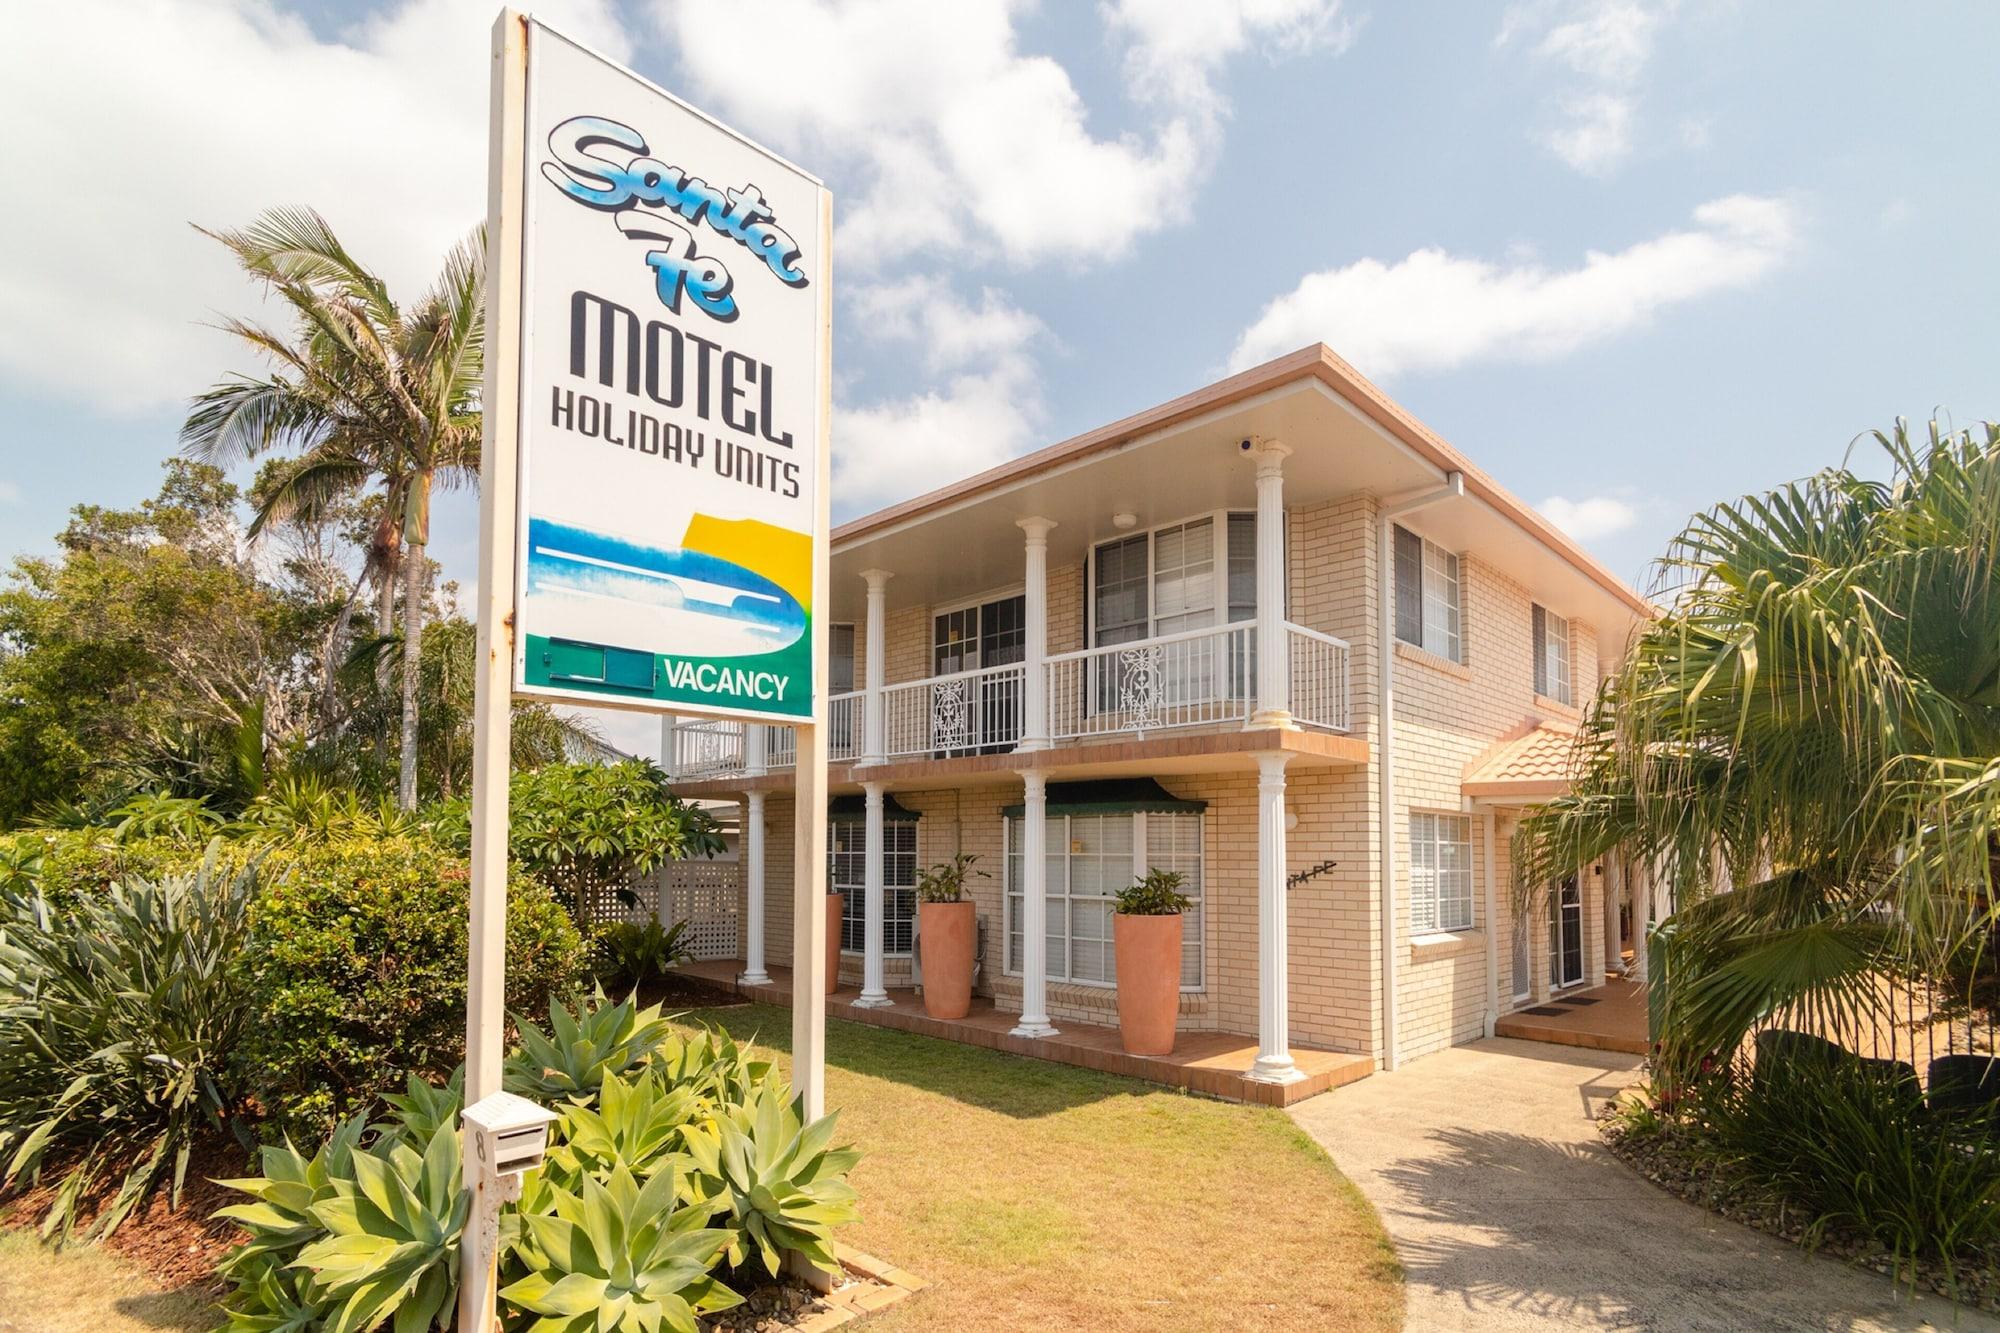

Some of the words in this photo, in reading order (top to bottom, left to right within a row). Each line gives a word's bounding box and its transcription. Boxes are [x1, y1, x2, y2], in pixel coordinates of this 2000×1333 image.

[541, 115, 809, 289] Santa
[614, 209, 740, 323] Fe
[570, 291, 793, 449] MOTEL
[552, 386, 704, 469] HOLIDAY
[715, 438, 800, 499] UNITS
[664, 659, 789, 701] VACANCY
[475, 1131, 486, 1162] 8
